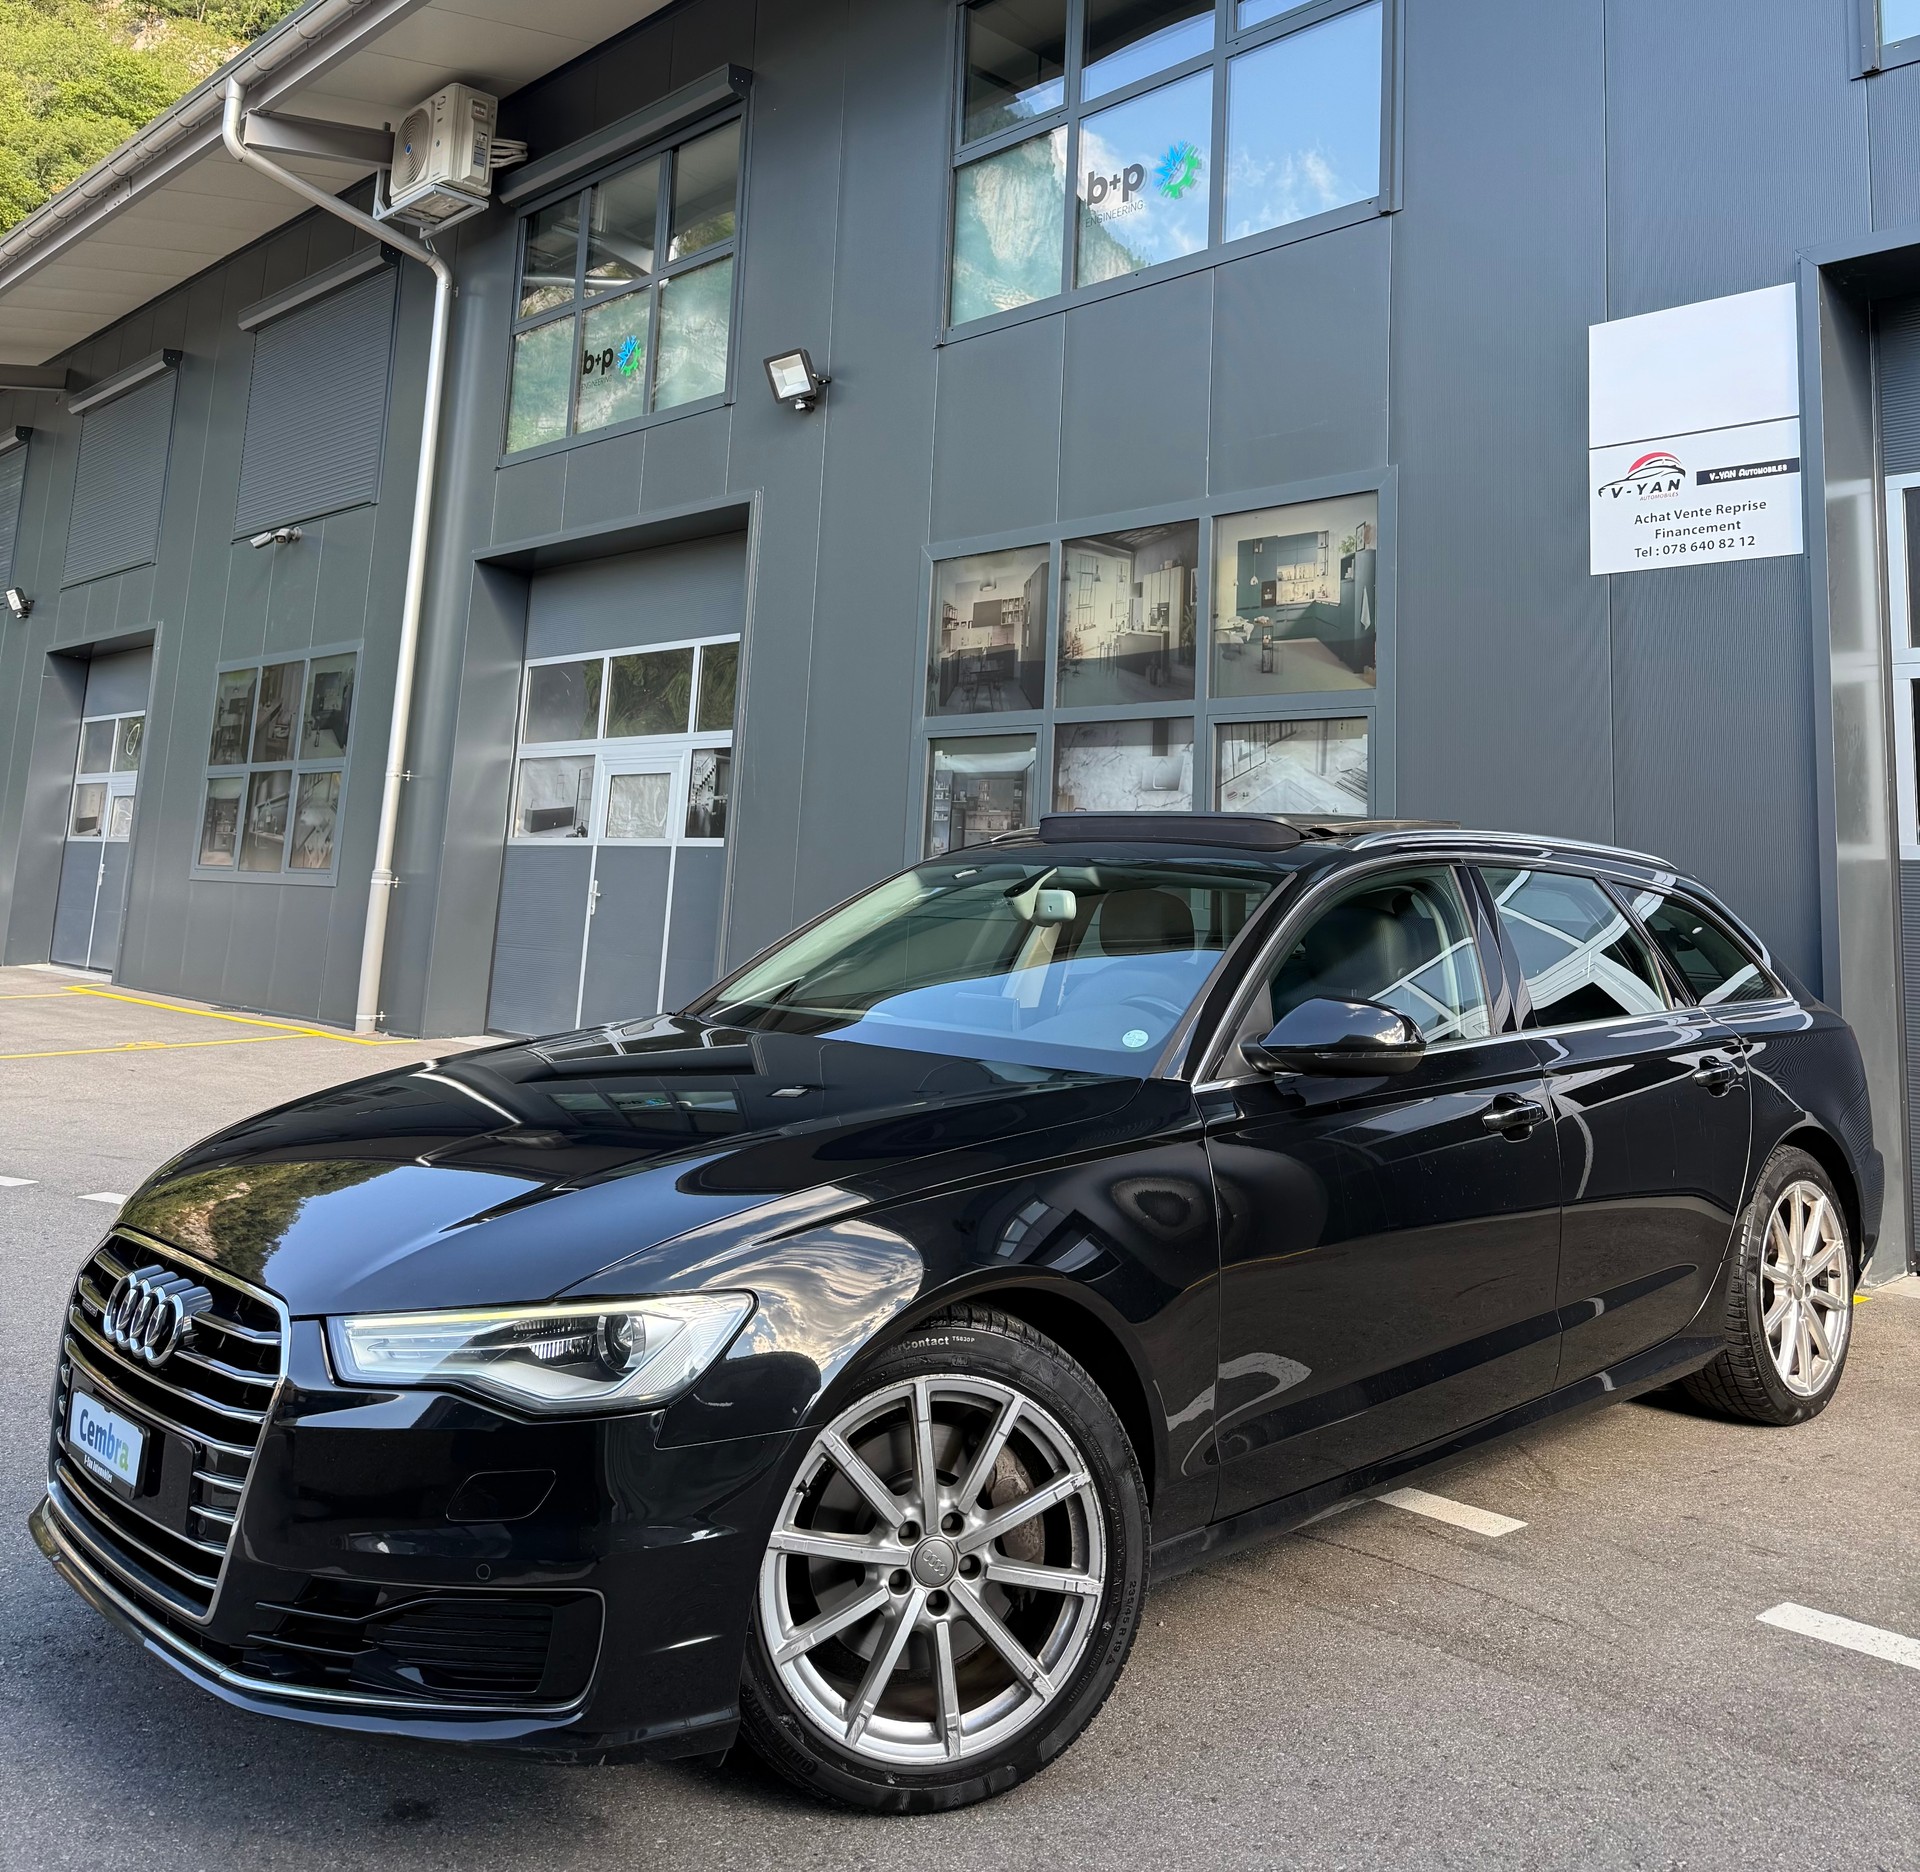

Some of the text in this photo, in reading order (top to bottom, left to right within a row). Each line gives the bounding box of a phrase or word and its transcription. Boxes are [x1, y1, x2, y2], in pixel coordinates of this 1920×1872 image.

[1087, 163, 1145, 207] b+p
[1085, 200, 1144, 228] ENGINEERING
[582, 347, 614, 375] b+p
[1710, 469, 1737, 481] V-YAN
[1610, 478, 1682, 499] V-YAN
[1639, 491, 1679, 501] AUTOMOBILES
[1634, 499, 1767, 525] Achat Vente Reprise
[1655, 520, 1742, 539] Financement
[1662, 543, 1687, 555] 078
[1690, 539, 1715, 552] 640
[1718, 537, 1735, 549] 82
[1739, 535, 1756, 547] 12
[79, 1408, 130, 1472] Cembra
[1112, 1580, 1138, 1653] 235/45 R 19
